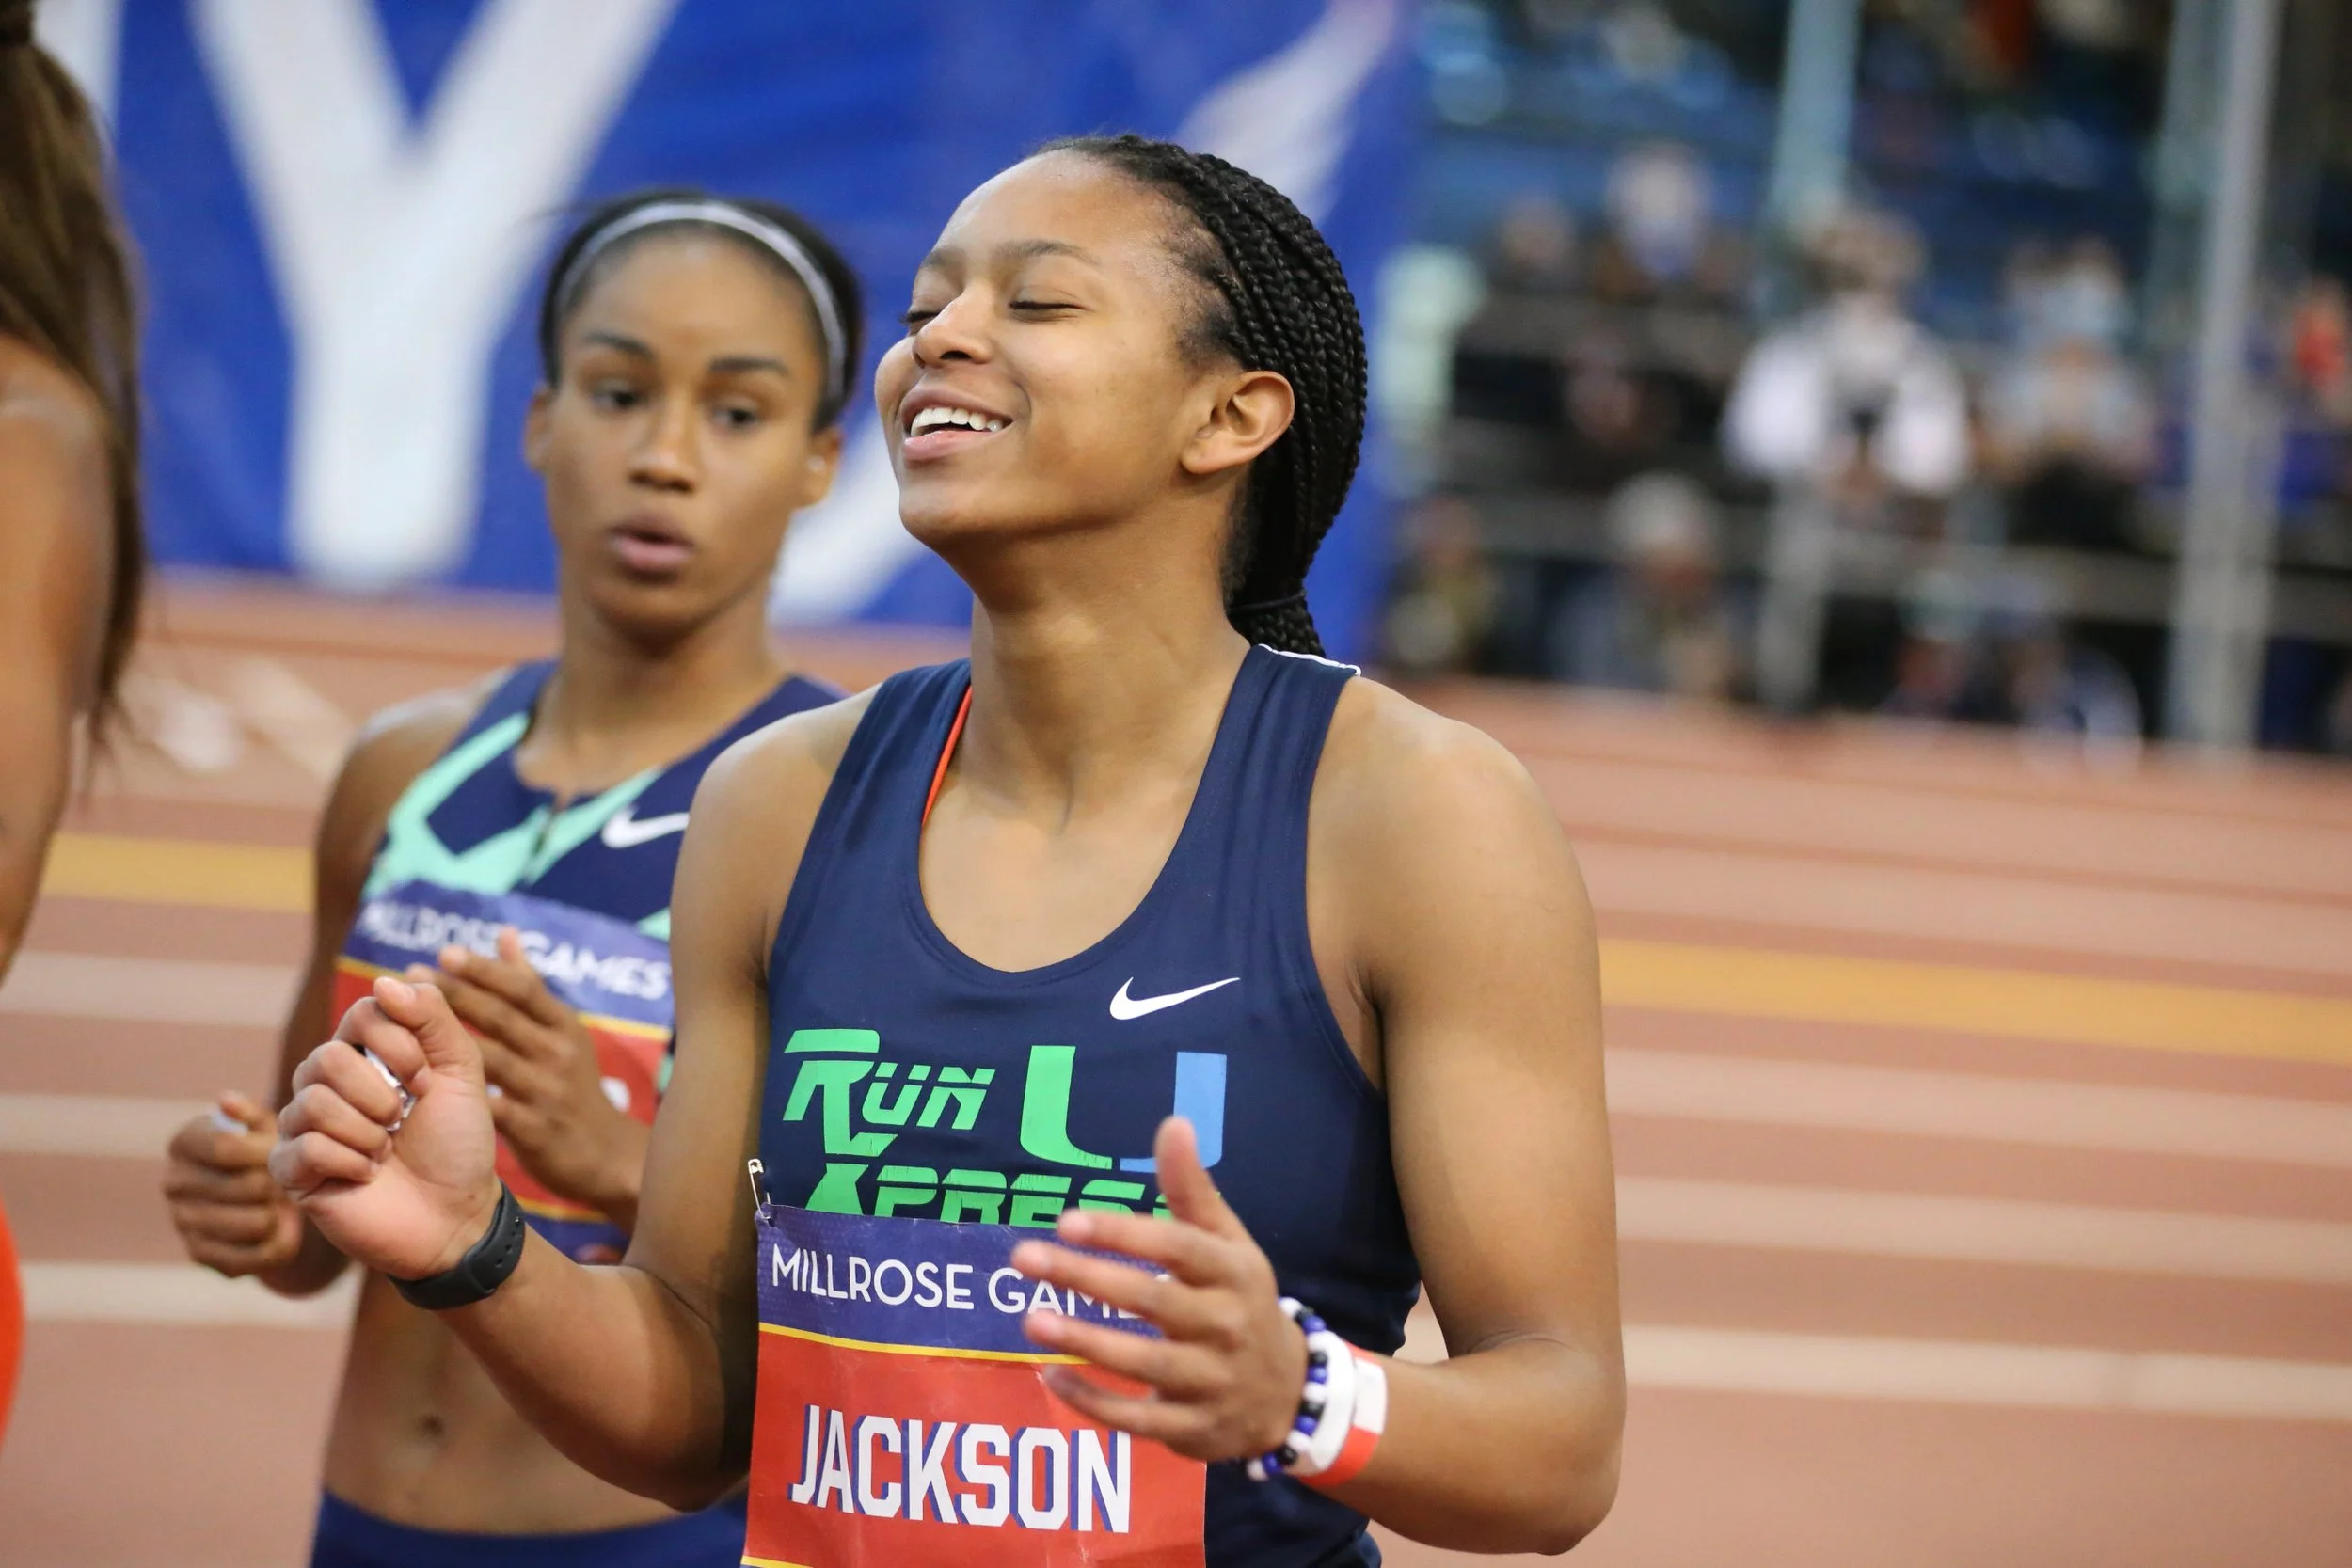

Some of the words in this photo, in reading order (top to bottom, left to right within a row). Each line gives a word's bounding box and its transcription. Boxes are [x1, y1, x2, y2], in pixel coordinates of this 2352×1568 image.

[805, 1163, 1221, 1228] XPRES
[772, 1243, 974, 1310] MILLROSE
[787, 1403, 1130, 1534] JACKSON
